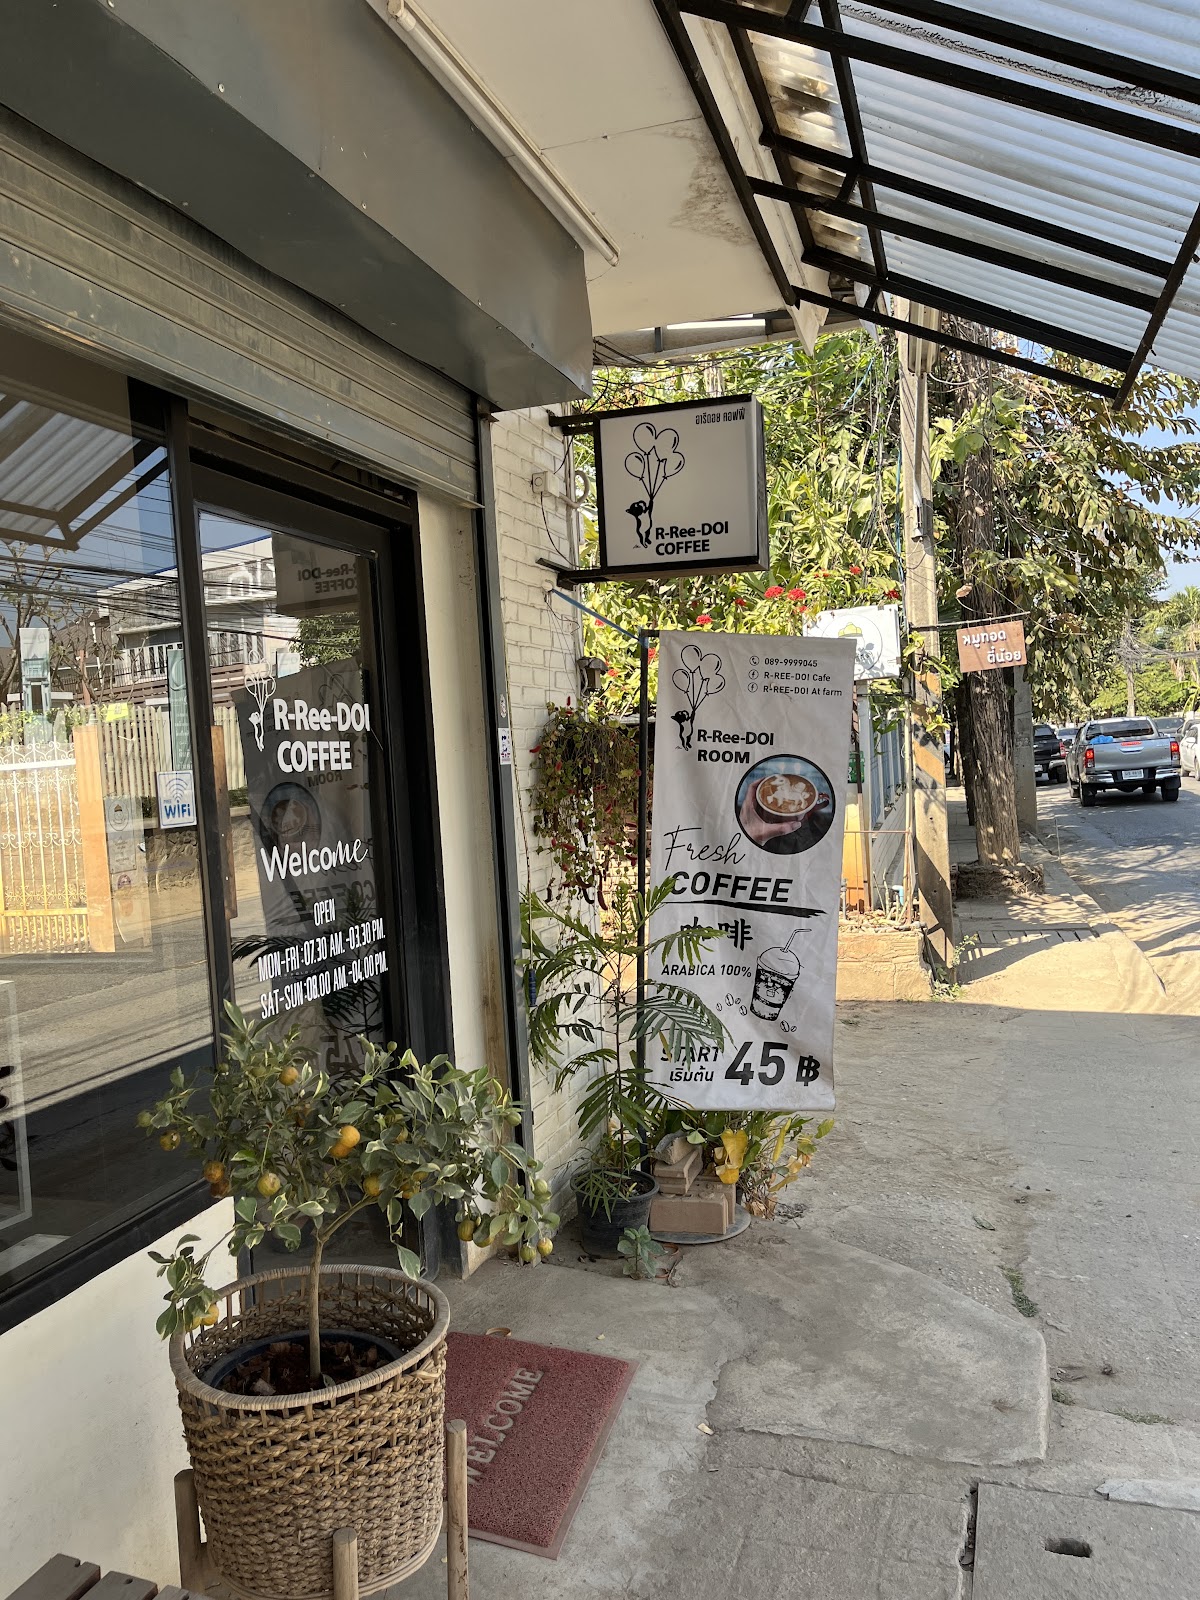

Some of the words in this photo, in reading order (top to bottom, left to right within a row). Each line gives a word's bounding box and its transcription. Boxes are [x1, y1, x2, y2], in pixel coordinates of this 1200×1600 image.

[655, 521, 729, 540] R-Ree-DOI
[655, 539, 710, 556] COFFEE
[764, 657, 818, 668] 089-9999045
[763, 671, 810, 681] R-REE-DOI
[812, 674, 831, 682] Cafe
[762, 685, 809, 695] R-REE-DOI
[811, 687, 821, 695] At
[822, 688, 843, 696] farm
[273, 698, 371, 732] R-Ree-DOI
[697, 729, 775, 746] R-Ree-DOI
[277, 740, 353, 773] COFFEE
[697, 750, 750, 764] ROOM
[260, 838, 369, 882] Welcome
[663, 825, 746, 871] Fresh
[671, 871, 793, 902] COFFEE
[313, 898, 336, 926] OPEN
[330, 931, 345, 957] AM.
[371, 917, 386, 941] PM.
[333, 965, 348, 991] AM.
[374, 950, 389, 976] PM.
[661, 965, 715, 976] ARABICA
[720, 965, 752, 978] 100%
[669, 1061, 715, 1082] เริ่มต้น
[724, 1041, 789, 1086] 45
